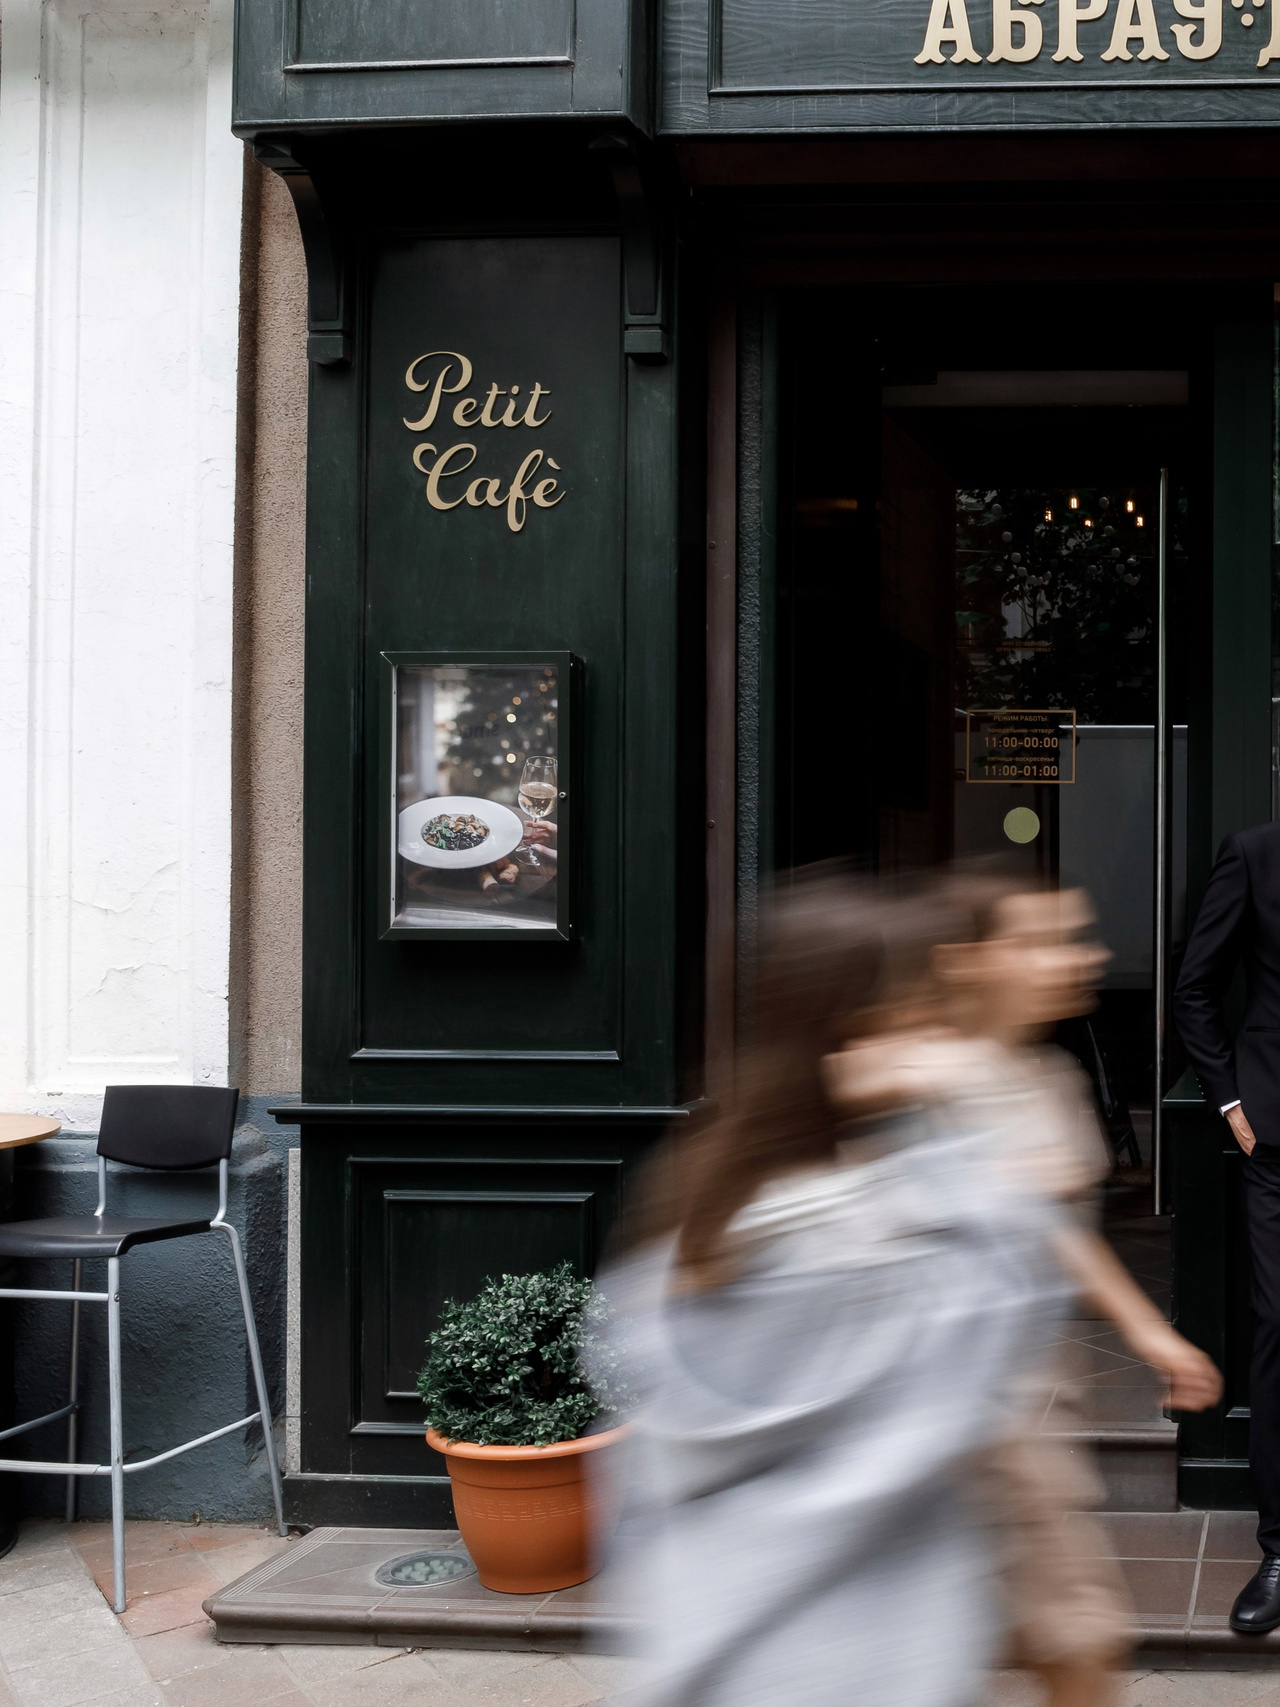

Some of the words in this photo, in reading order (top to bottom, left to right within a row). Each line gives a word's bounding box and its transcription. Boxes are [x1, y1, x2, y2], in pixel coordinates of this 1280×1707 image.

[402, 350, 553, 432] Petit
[984, 736, 1059, 748] 11:00-00:00
[984, 765, 1058, 776] 11:00-01:00
